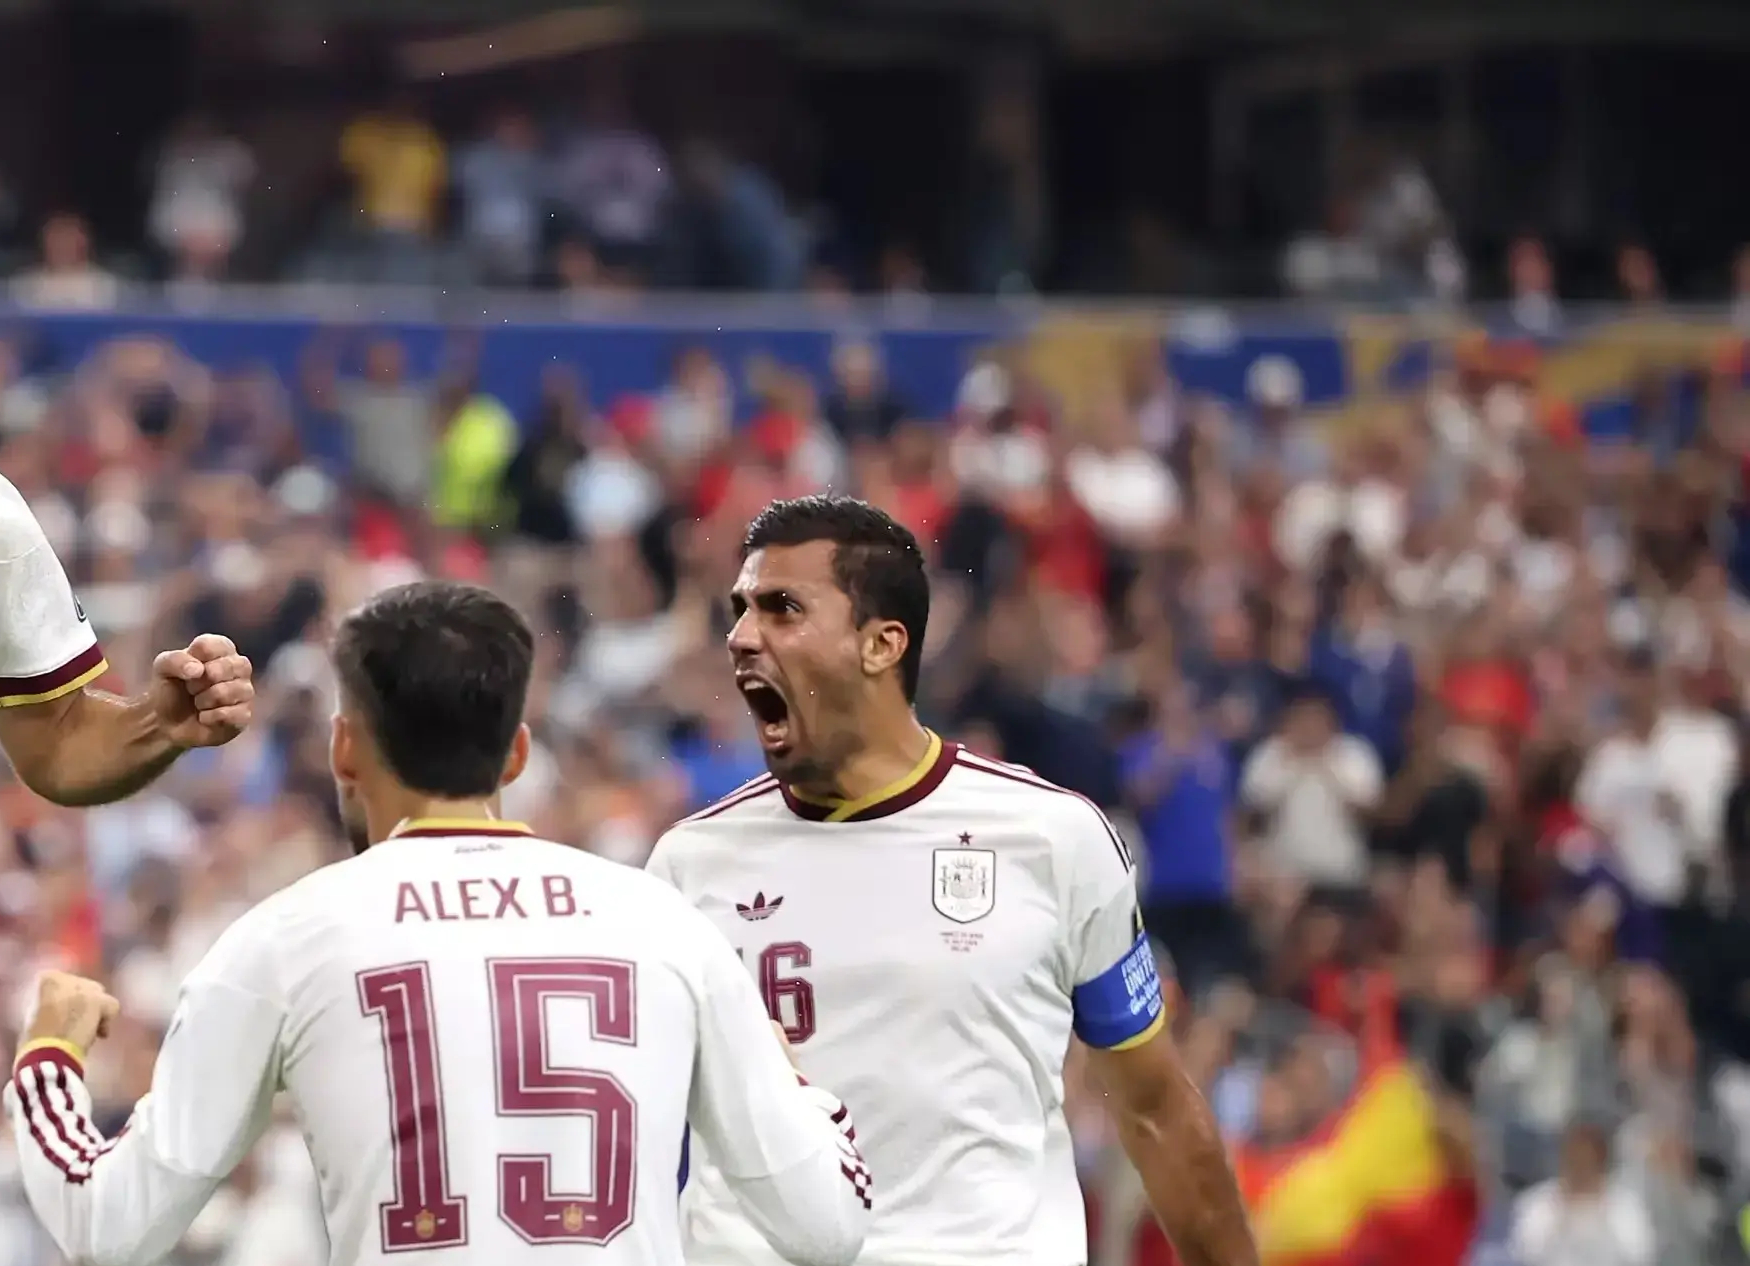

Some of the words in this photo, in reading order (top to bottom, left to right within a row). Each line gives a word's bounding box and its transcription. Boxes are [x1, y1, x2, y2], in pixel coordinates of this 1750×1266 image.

[394, 878, 529, 923] ALEX
[541, 874, 592, 918] B.
[735, 941, 816, 1044] 6
[355, 957, 638, 1254] 15
